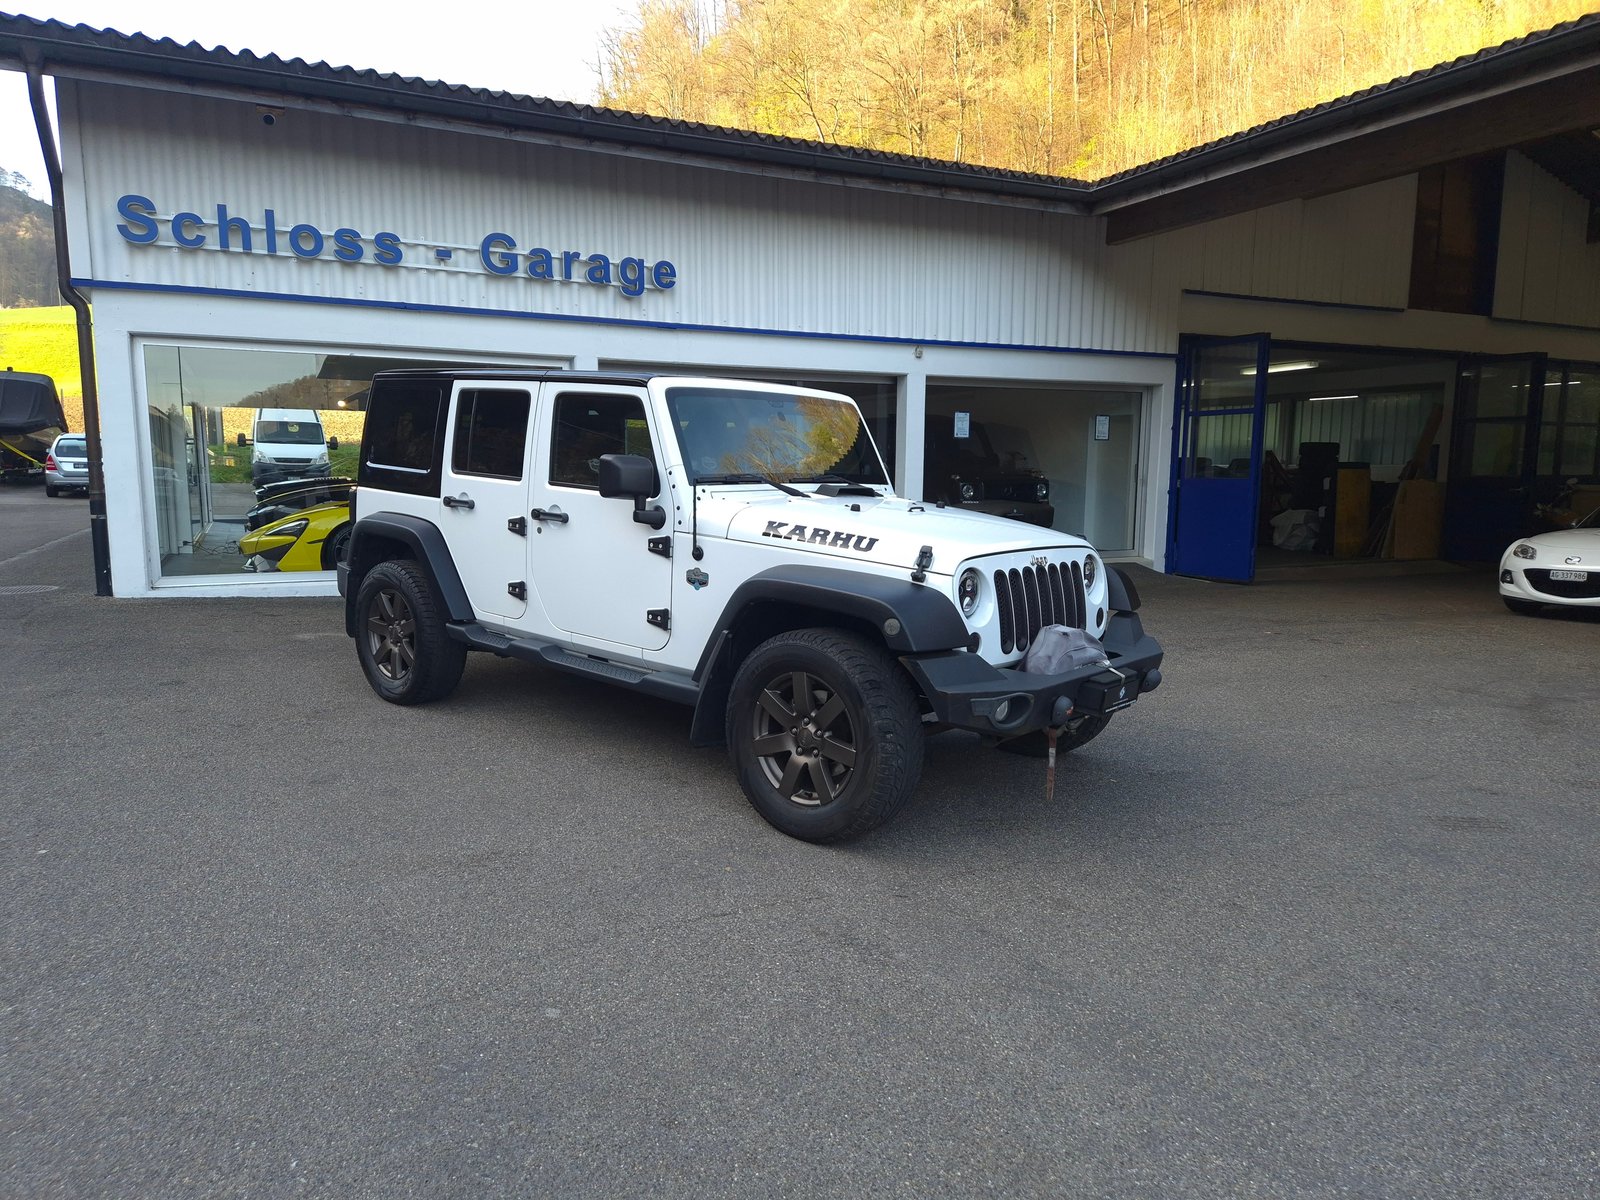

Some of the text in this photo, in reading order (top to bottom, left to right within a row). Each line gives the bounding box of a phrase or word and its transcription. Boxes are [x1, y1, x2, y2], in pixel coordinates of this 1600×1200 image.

[116, 194, 677, 297] Schloss - Garage
[761, 520, 880, 552] KARHU
